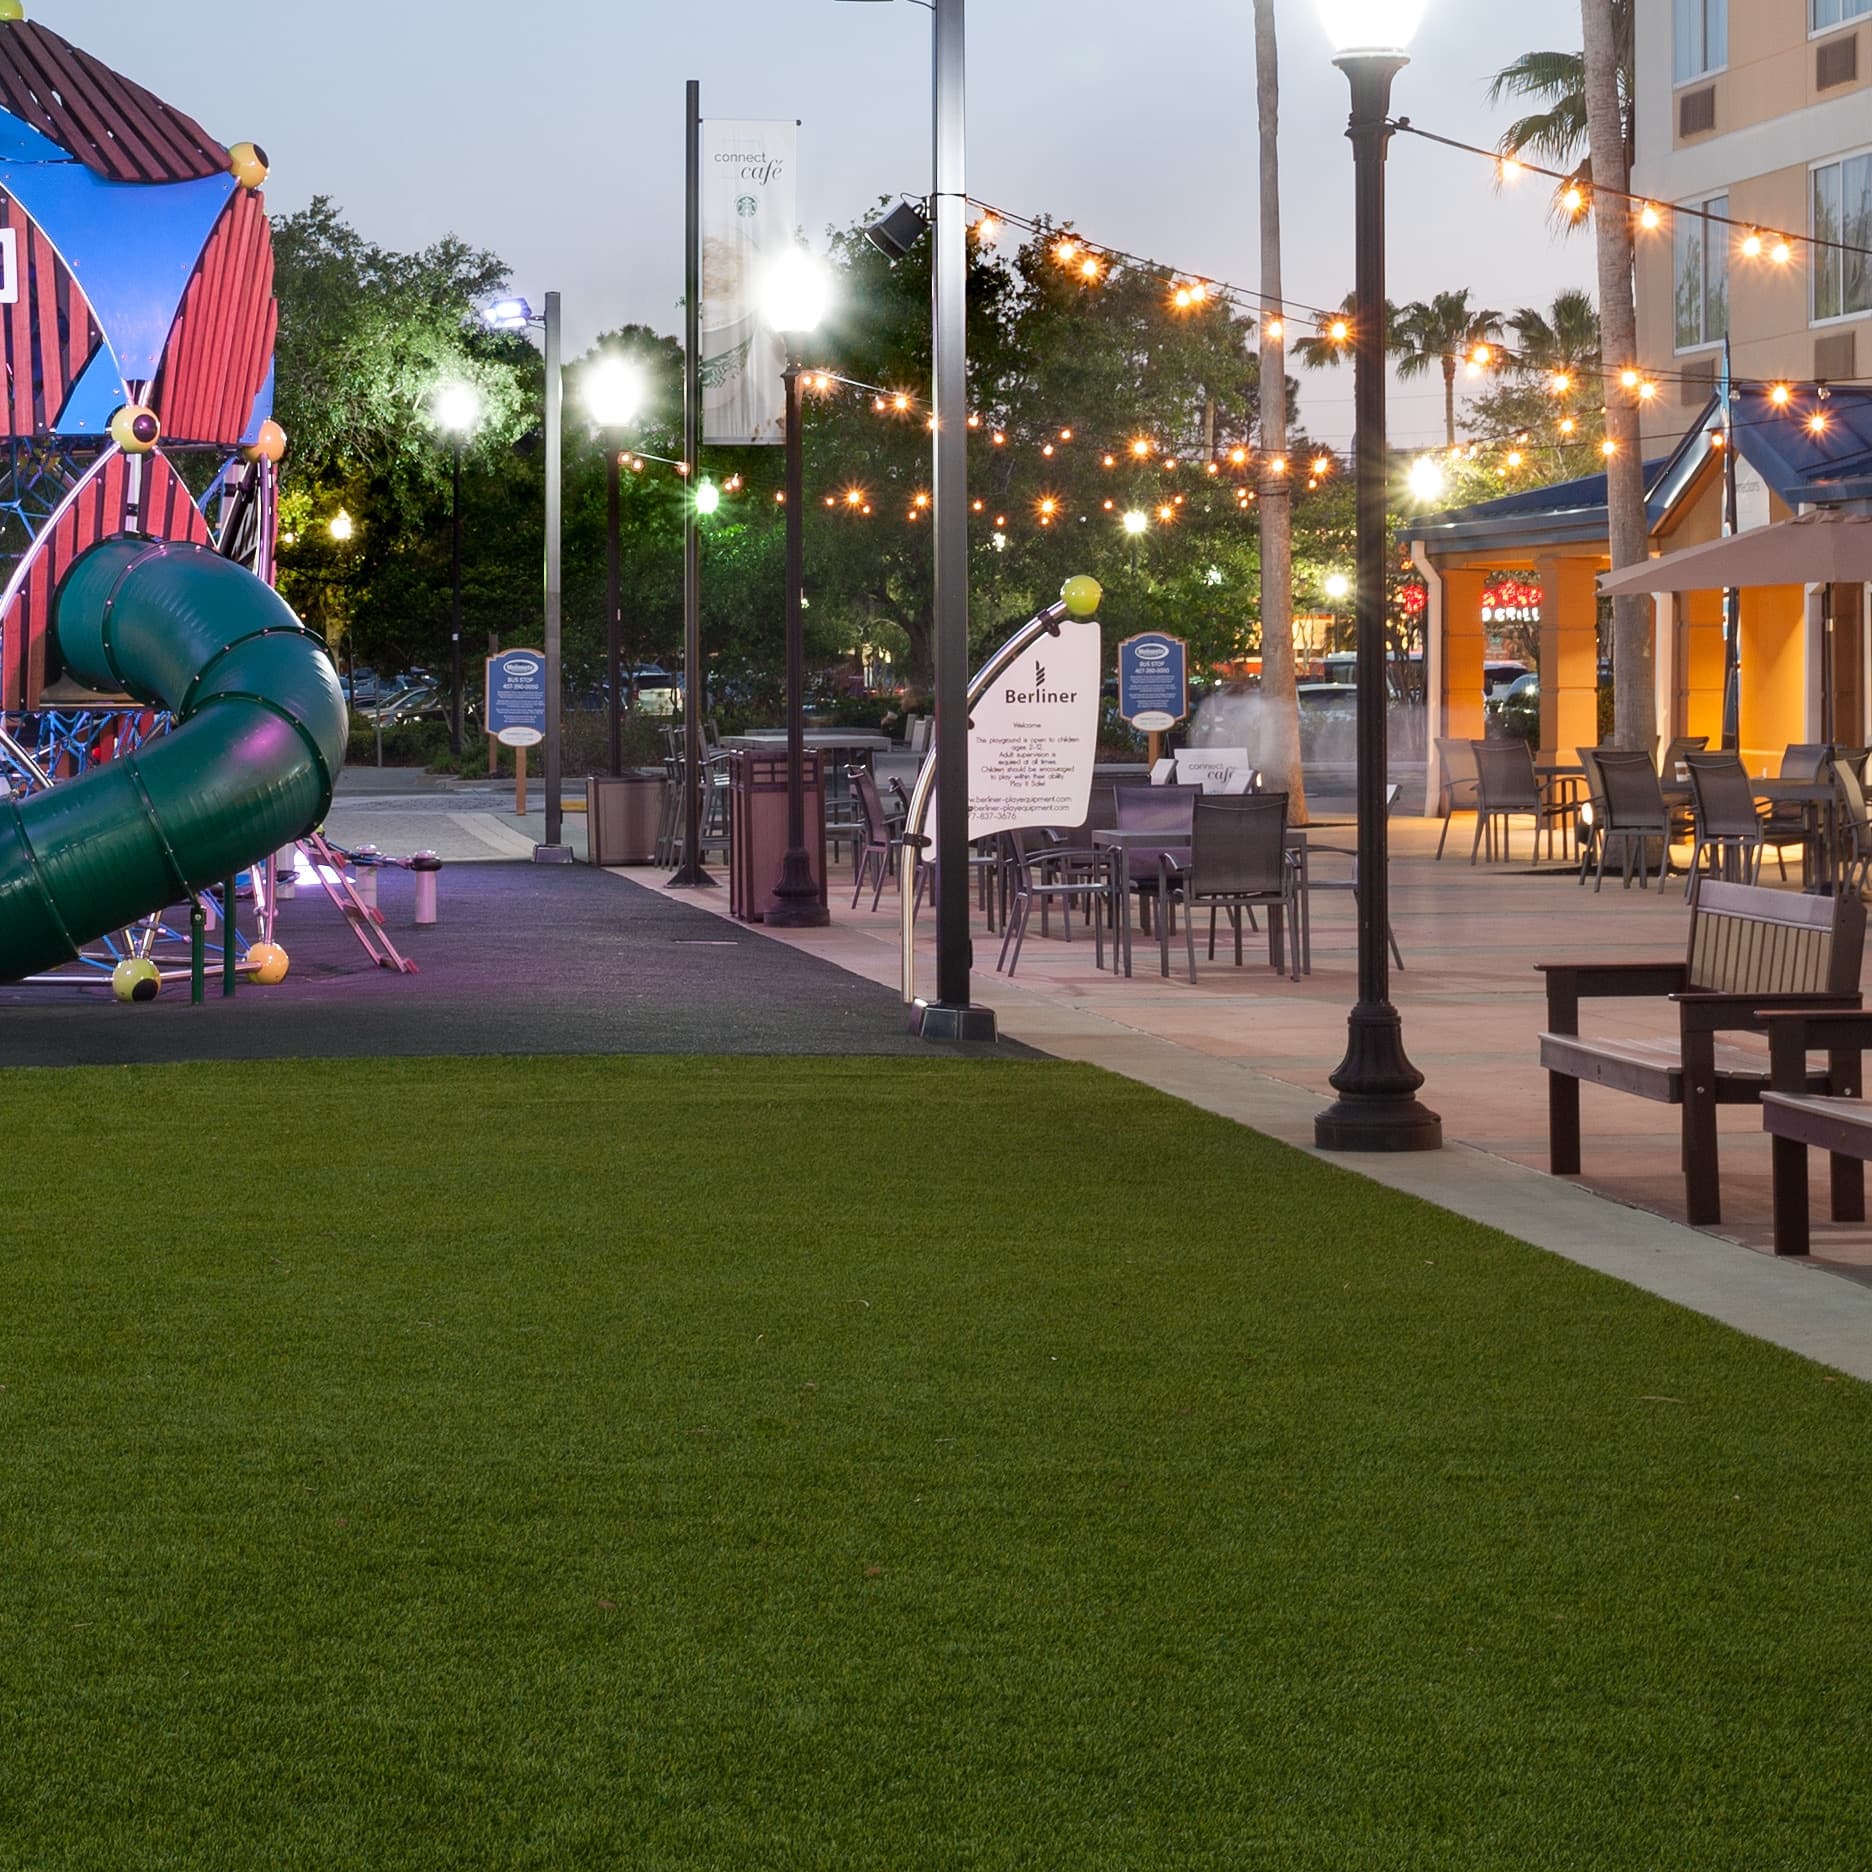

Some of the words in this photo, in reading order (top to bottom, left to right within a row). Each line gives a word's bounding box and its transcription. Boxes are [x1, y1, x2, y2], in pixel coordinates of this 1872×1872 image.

[714, 152, 766, 163] connect
[740, 159, 783, 185] café
[1005, 688, 1078, 704] Berliner
[989, 736, 1022, 745] playground
[1057, 735, 1080, 743] children
[1016, 751, 1049, 759] supervision
[1039, 765, 1075, 774] encouraged
[1188, 762, 1224, 771] connect
[998, 773, 1011, 781] play
[1009, 780, 1022, 788] Play
